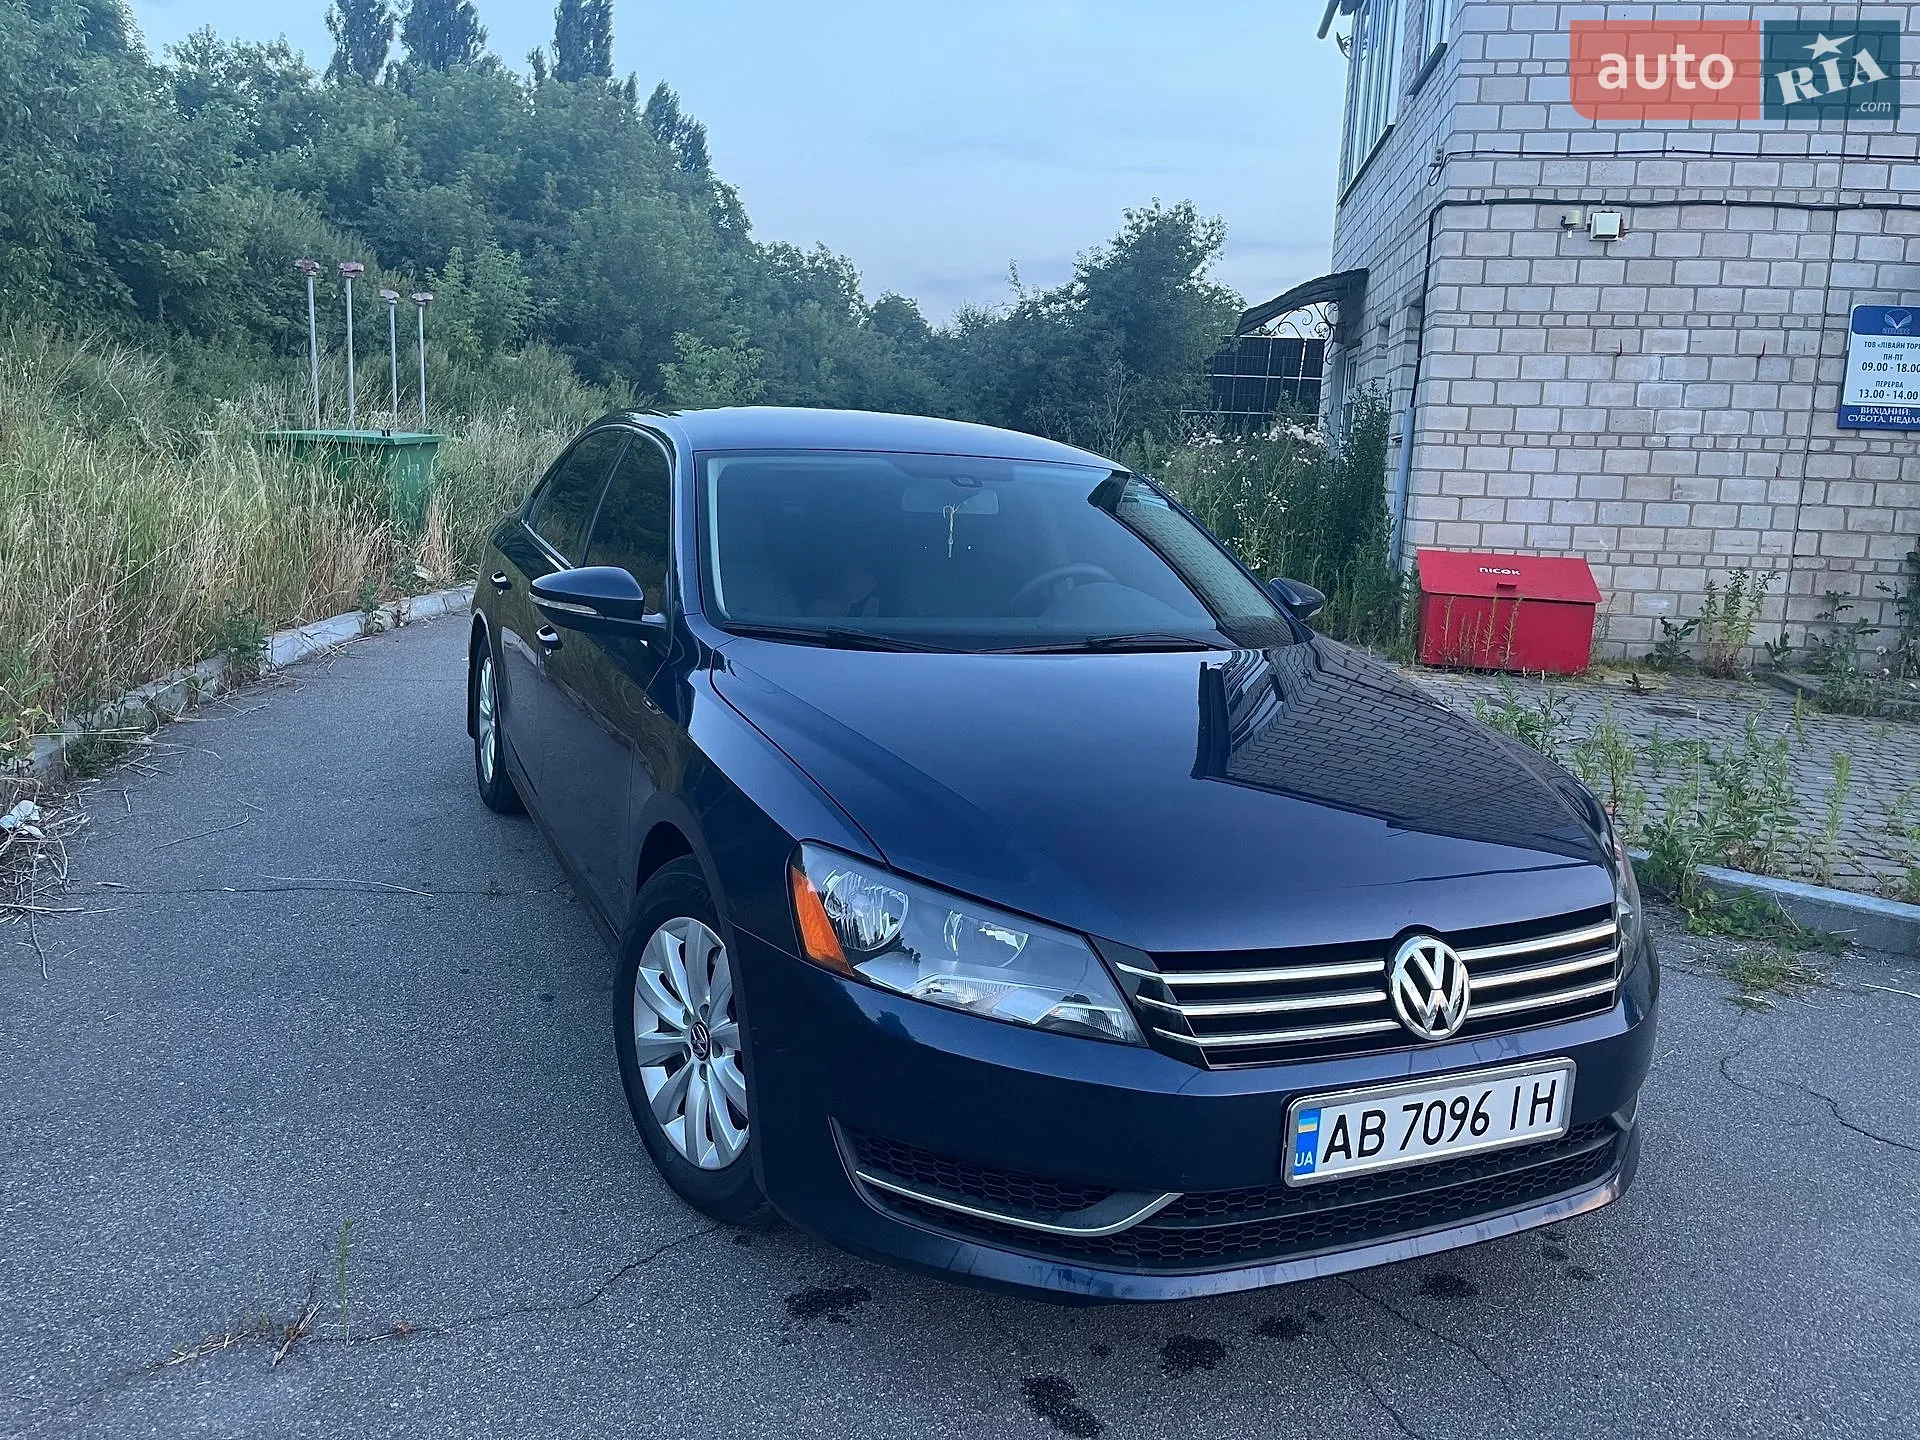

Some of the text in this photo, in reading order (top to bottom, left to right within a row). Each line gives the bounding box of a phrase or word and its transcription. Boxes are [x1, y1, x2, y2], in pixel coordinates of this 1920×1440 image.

[1883, 353, 1903, 361] ПН-ПТ
[1861, 361, 1888, 372] 09.00
[1875, 380, 1904, 388] ПЕРЕРВА
[1859, 388, 1885, 399] 13.00
[1893, 390, 1919, 400] 14.00
[1322, 1079, 1557, 1164] AB 7096 IH
[1294, 1150, 1314, 1168] UA
